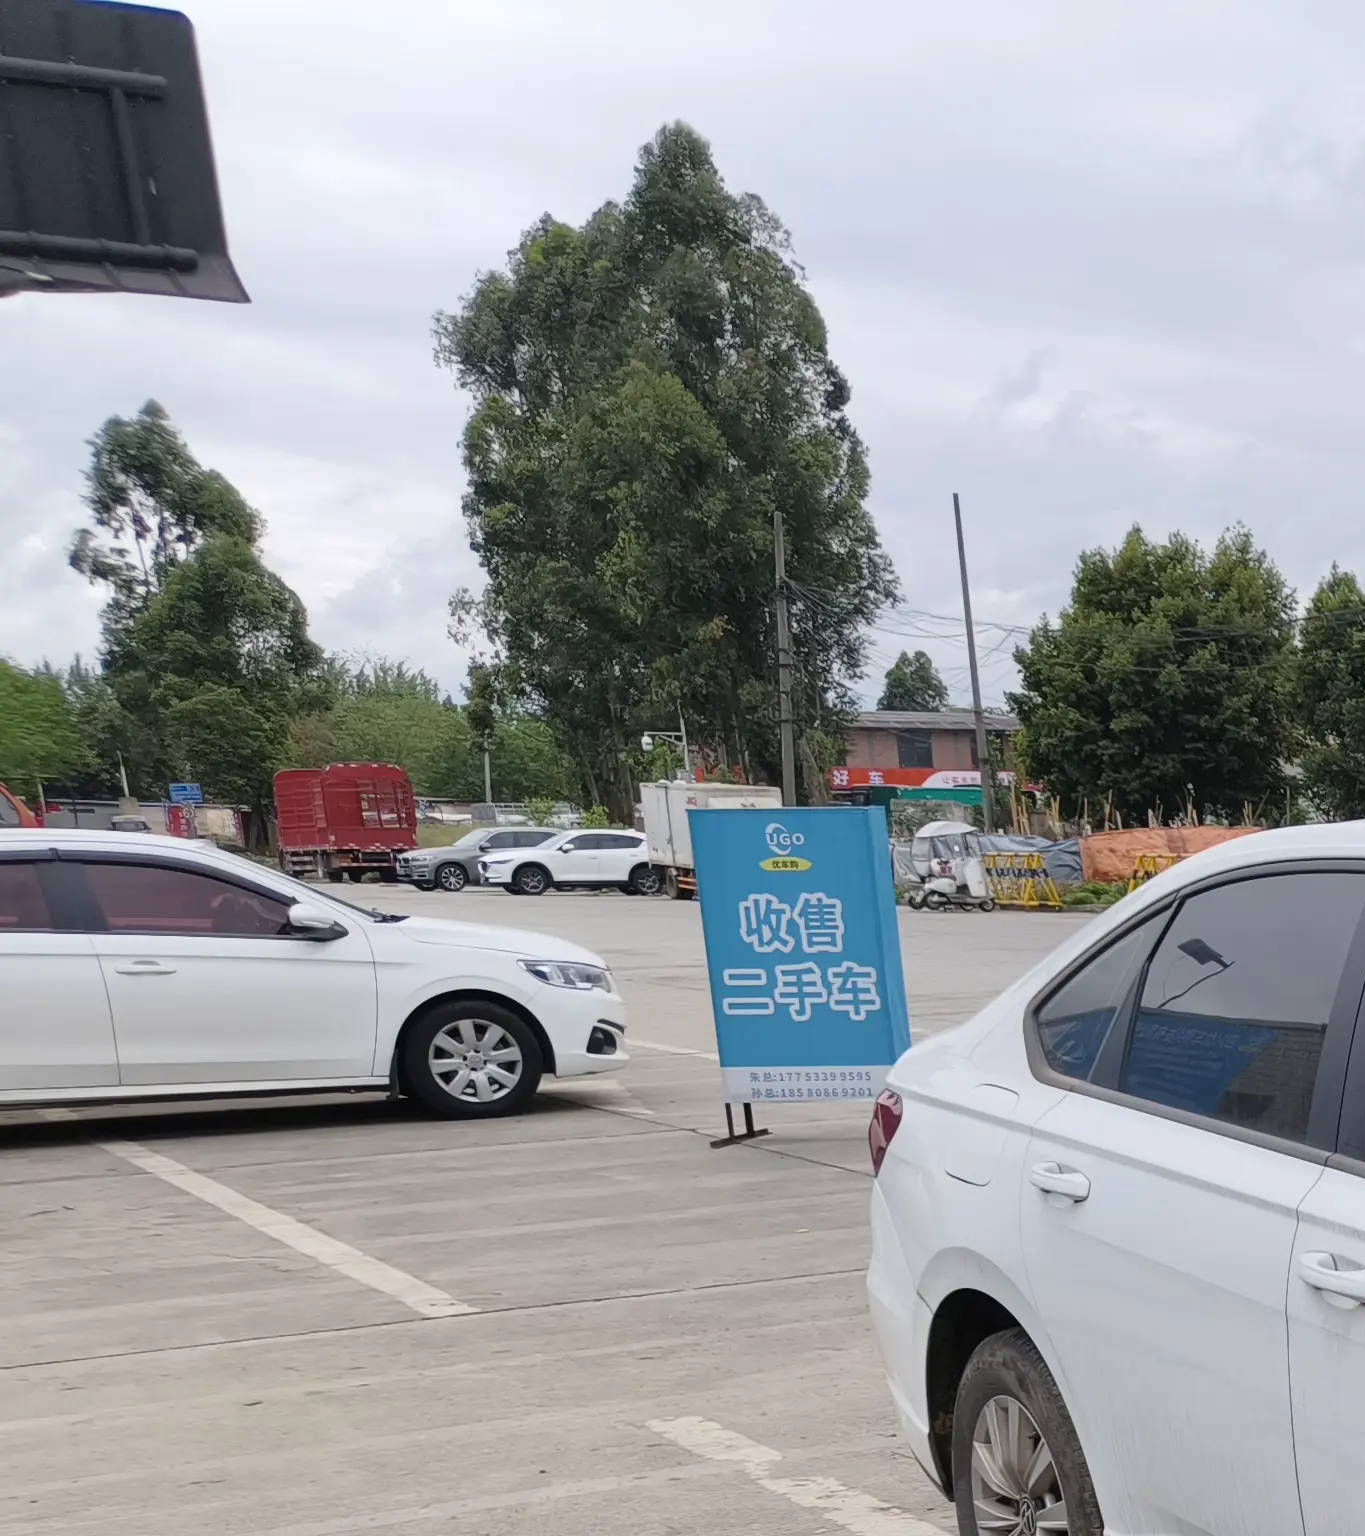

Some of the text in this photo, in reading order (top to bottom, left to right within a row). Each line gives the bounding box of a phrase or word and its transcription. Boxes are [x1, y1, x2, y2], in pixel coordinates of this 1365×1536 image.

[771, 859, 799, 869] 优车购
[738, 892, 845, 954] 收售
[723, 961, 882, 1022] 二手车
